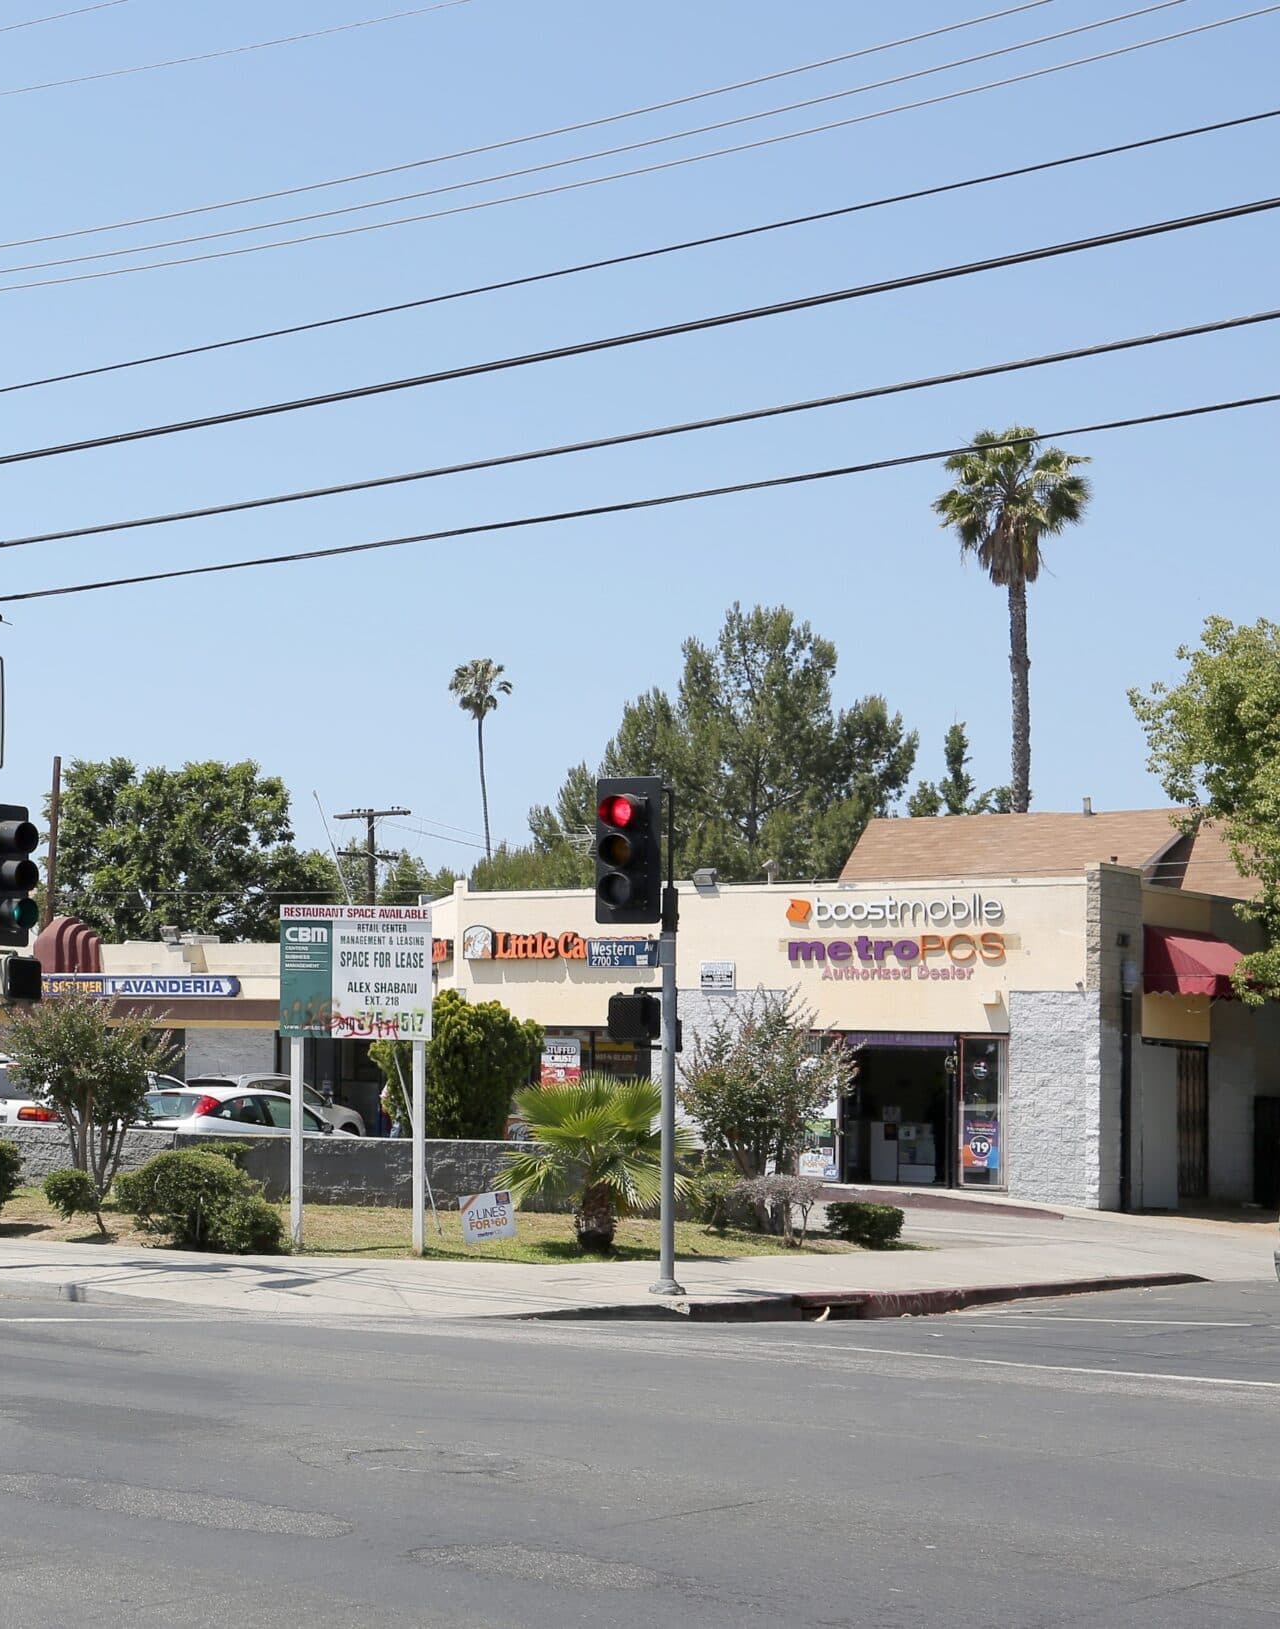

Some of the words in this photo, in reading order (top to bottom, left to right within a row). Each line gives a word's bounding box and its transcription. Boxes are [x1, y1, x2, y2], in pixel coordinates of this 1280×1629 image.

[284, 907, 344, 918] RESTAURANT
[347, 908, 376, 918] SPACE
[379, 908, 428, 919] AVAILABLE
[816, 893, 1003, 920] boostmobile
[285, 927, 328, 942] CBM
[357, 924, 379, 932] RETAIL
[382, 924, 407, 933] CENTER
[340, 936, 386, 945] MANAGEMENT
[389, 936, 394, 945] &
[396, 937, 425, 946] LEASING
[495, 931, 556, 960] Little
[787, 932, 1006, 962] metroPCS
[591, 942, 635, 956] Western
[340, 951, 369, 967] SPACE
[374, 952, 391, 967] FOR
[395, 952, 424, 968] LEASE
[591, 956, 611, 966] 2700
[614, 956, 620, 966] S
[821, 964, 912, 980] Authorized
[917, 965, 974, 981] Dealer
[111, 980, 224, 993] LAVANDERIA
[347, 981, 371, 993] ALEX
[374, 982, 418, 994] SHABANI
[365, 996, 382, 1006] EXT.
[385, 997, 400, 1006] 218
[971, 1141, 990, 1154] $19
[468, 1210, 475, 1221] 2
[476, 1205, 507, 1220] LINES
[469, 1219, 490, 1230] FOR
